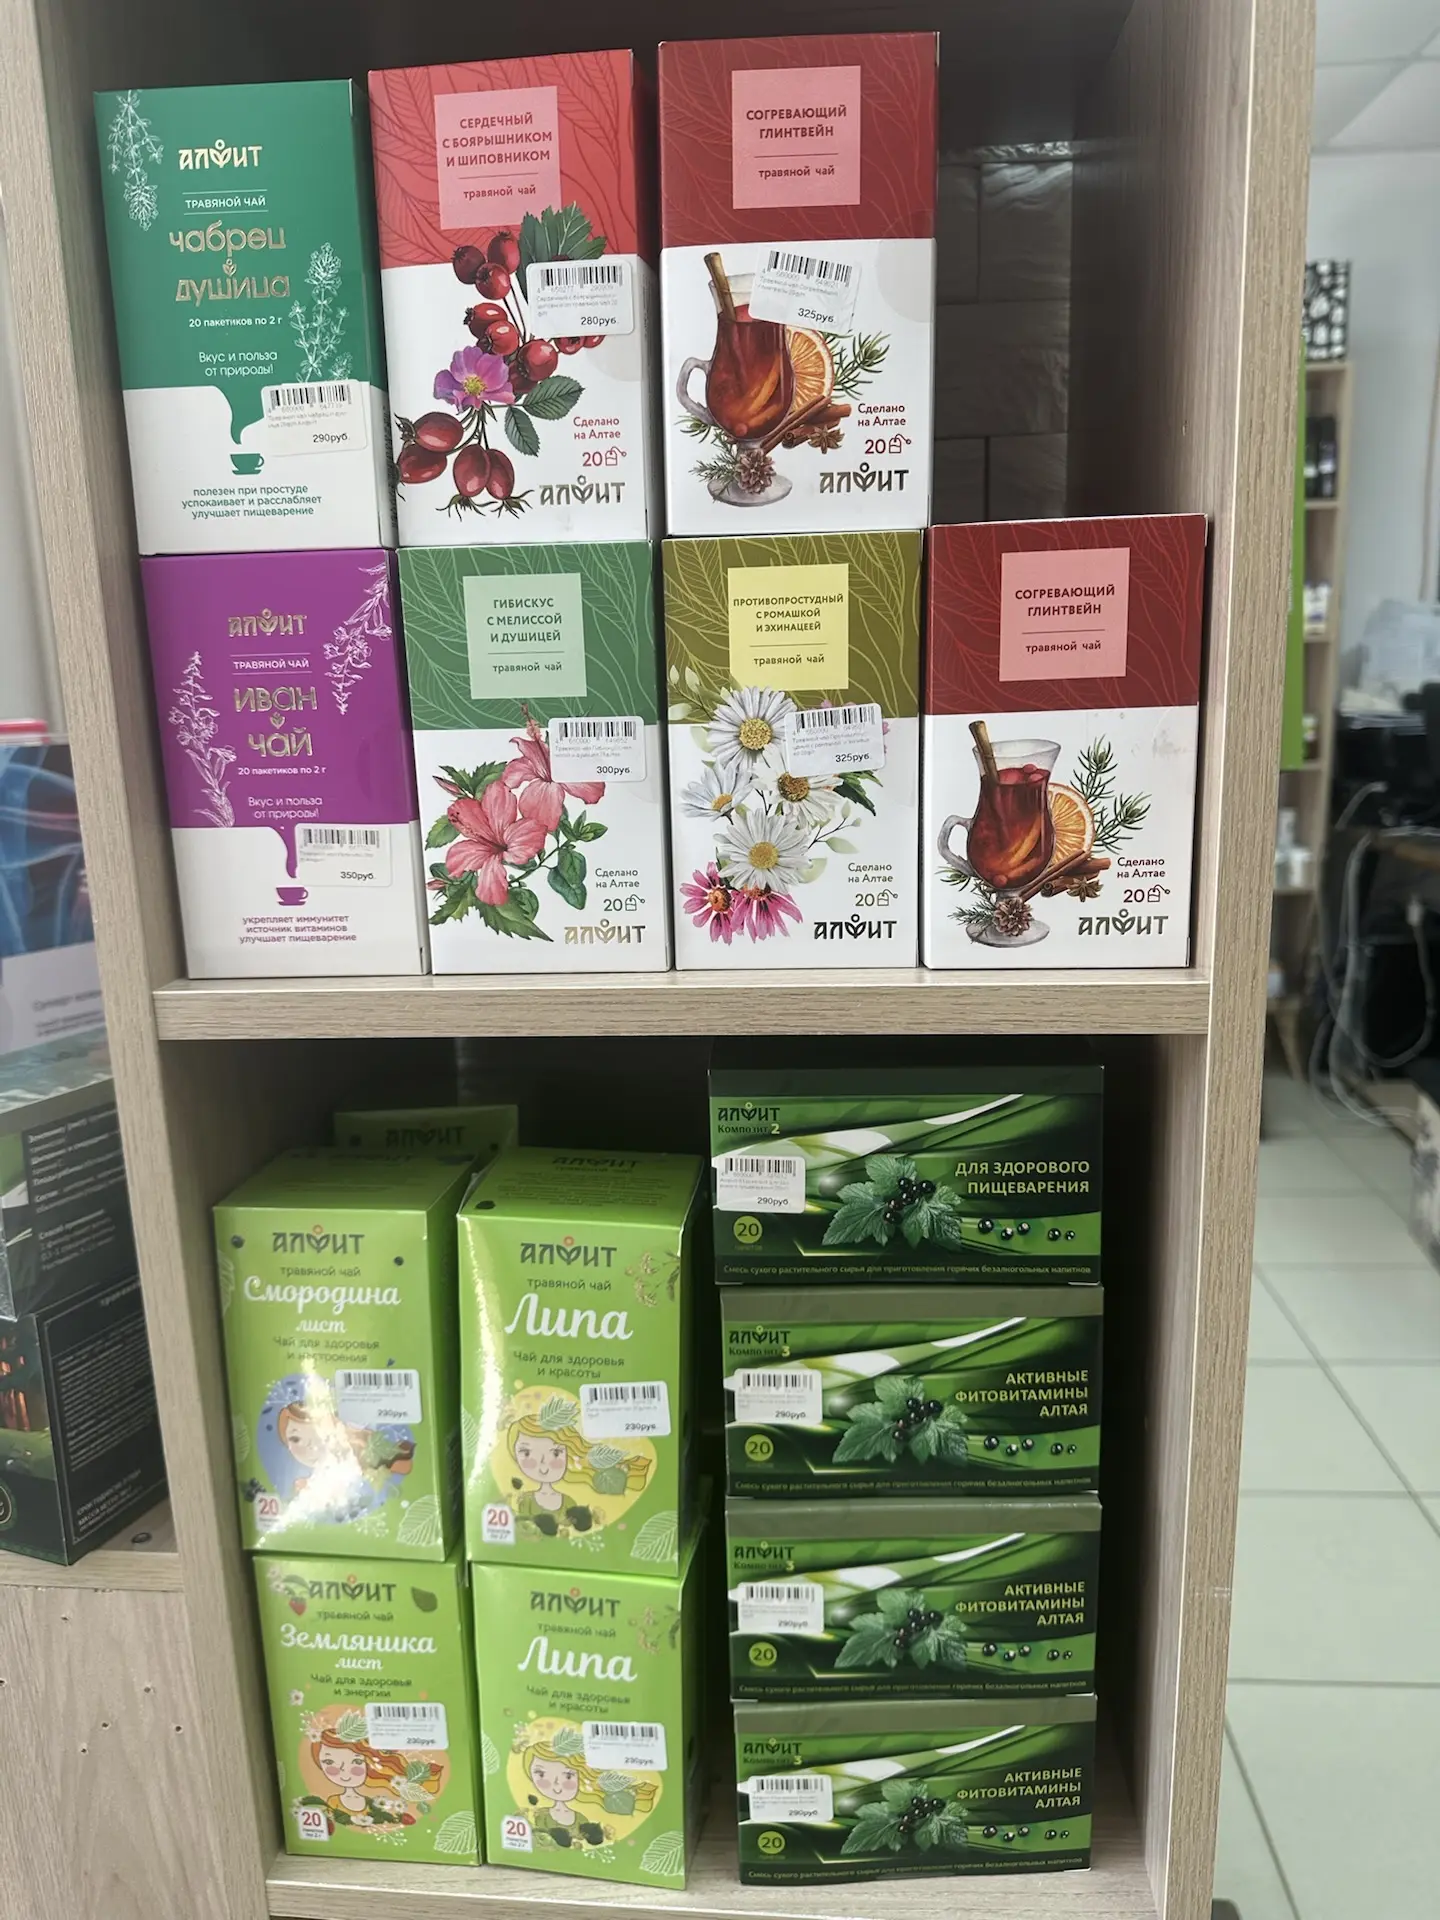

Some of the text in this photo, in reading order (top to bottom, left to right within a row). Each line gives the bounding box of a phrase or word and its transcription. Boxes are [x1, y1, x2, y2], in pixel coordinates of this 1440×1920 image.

[746, 104, 847, 121] СОГРЕВАЮЩИЙ
[460, 111, 534, 129] СЕРДЕЧНЫЙ
[759, 125, 834, 140] ГЛИНТВЕЙН
[442, 131, 553, 149] С БОЯРЫШНИКОМ
[446, 150, 550, 167] И ШИПОВНИКОМ
[758, 165, 835, 180] травяной чай
[463, 184, 536, 200] травяной чай
[185, 195, 266, 209] ТРАВЯНОЙ ЧАЙ
[169, 220, 286, 257] чабрец
[175, 275, 291, 307] душица
[189, 316, 275, 328] 20 пакетиков по 2
[199, 351, 278, 363] Вкус польза
[205, 363, 274, 378] от природы!
[857, 403, 905, 414] Сделано
[573, 416, 620, 428] Сделано
[857, 416, 907, 427] на Алтае
[574, 429, 621, 440] на Алтае
[864, 439, 886, 454] 20
[582, 451, 603, 467] 20
[193, 484, 309, 498] полезен при простуде
[181, 494, 322, 509] успокаивает расслабляет
[191, 506, 314, 520] улучшает пищеварение
[1015, 584, 1115, 600] СОГРЕВАЮЩИЙ
[493, 598, 554, 609] ГИБИСКУС
[733, 593, 844, 607] ПРОТИВОПРОСТУДНЫЙ
[756, 608, 821, 619] С РОМАШКОЙ
[1028, 602, 1102, 617] ГЛИНТВЕЙН
[487, 613, 562, 626] С МЕЛИССОЙ
[756, 622, 821, 633] И ЭХИНАЦЕЕЙ
[490, 630, 561, 645] И ДУШИЦЕЙ
[1026, 640, 1101, 655] травяной чай
[233, 658, 309, 670] ТРАВЯНОЙ ЧАЙ
[754, 653, 825, 667] травяной чай
[493, 662, 563, 675] травяной чай
[238, 766, 312, 776] 20 пакетиков по
[248, 796, 323, 808] Вкус польза
[254, 808, 320, 820] от природы!
[848, 862, 893, 872] Сделано
[1117, 856, 1165, 867] Сделано
[595, 868, 638, 877] Сделано
[862, 873, 894, 883] Алтае
[1117, 868, 1166, 879] на Алтае
[609, 879, 640, 888] Алтае
[855, 893, 875, 907] 20
[1123, 889, 1145, 903] 20
[603, 898, 623, 912] 20
[242, 915, 350, 925] укрепляет иммунитет
[246, 925, 348, 934] источник витаминов
[239, 933, 357, 944] улучшает пищеварение
[770, 1123, 780, 1135] 2
[955, 1161, 1090, 1177] ДЛЯ ЗДОРОВОГО
[967, 1180, 1090, 1196] ПИЩЕВАРЕНИЯ
[737, 1222, 759, 1237] 20
[750, 1266, 777, 1275] сухого
[778, 1266, 837, 1275] растительного
[981, 1264, 1049, 1274] безалкогольных
[1051, 1266, 1092, 1274] напитков
[527, 1278, 612, 1291] травяной чай
[243, 1275, 402, 1315] Смородина
[504, 1292, 634, 1340] Липа
[296, 1319, 347, 1334] лист
[513, 1351, 625, 1367] Чай для здоровья
[550, 1368, 601, 1379] красоты
[1006, 1370, 1088, 1385] АКТИВНЫЕ
[955, 1387, 1088, 1403] ФИТОВИТАМИНЫ
[1039, 1404, 1088, 1417] АЛТАЯ
[749, 1442, 771, 1455] 20
[487, 1509, 509, 1527] 20
[1004, 1581, 1085, 1596] АКТИВНЫЕ
[956, 1597, 1084, 1612] ФИТОВИТАМИНЫ
[1036, 1613, 1084, 1626] АЛТАЯ
[280, 1623, 437, 1654] Земляника
[517, 1635, 638, 1683] Липа
[753, 1648, 774, 1661] 20
[335, 1656, 383, 1671] лист
[1004, 1767, 1082, 1783] АКТИВНЫЕ
[957, 1782, 1081, 1799] ФИТОВИТАМИНЫ
[1035, 1796, 1080, 1809] АЛТАЯ
[302, 1811, 321, 1827] 20
[506, 1820, 526, 1837] 20
[762, 1837, 782, 1849] 20
